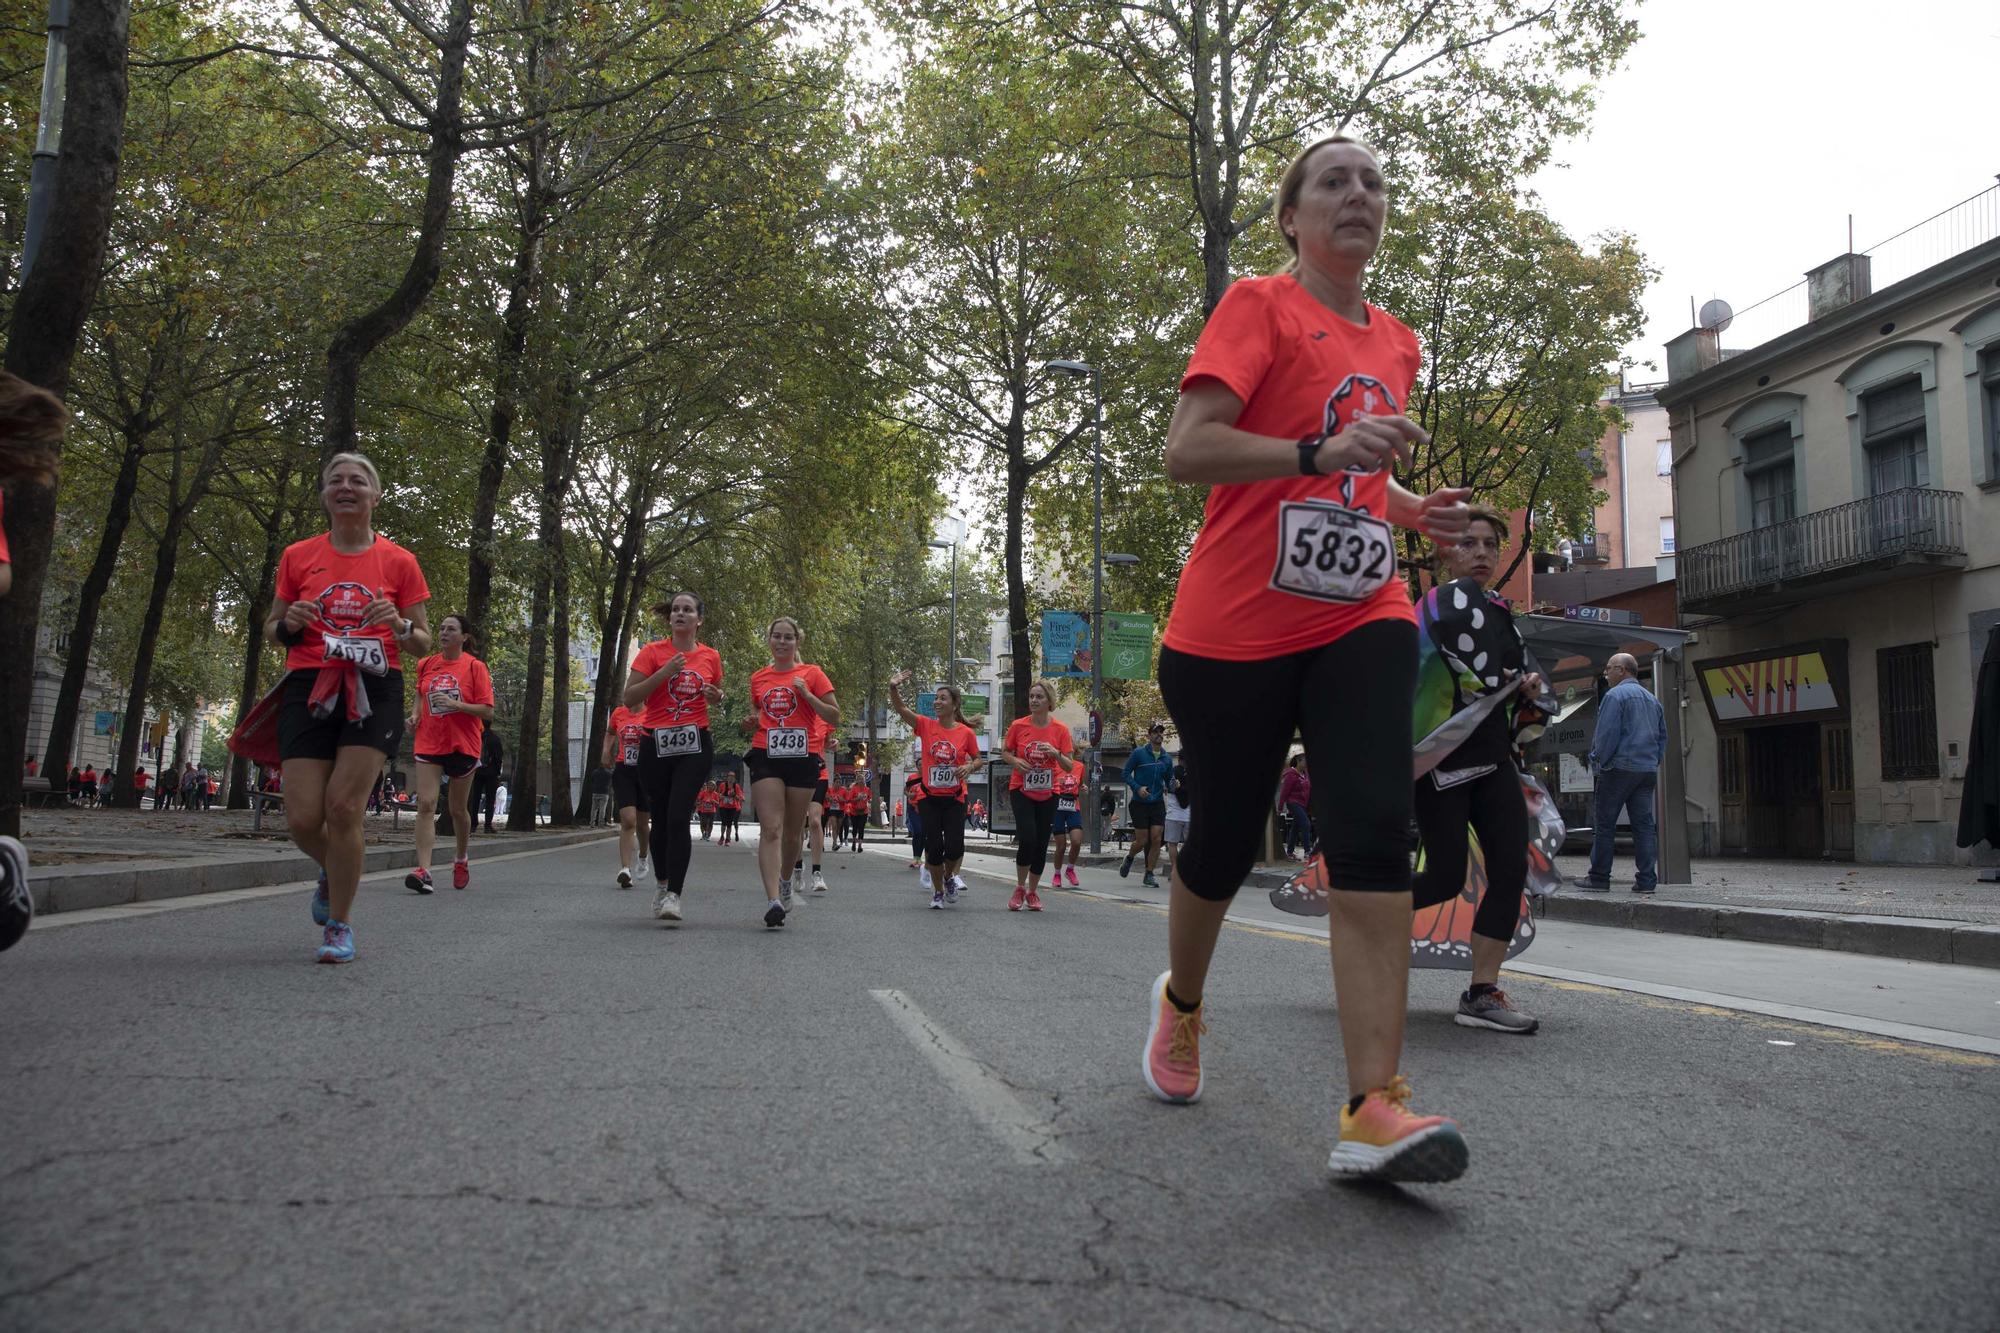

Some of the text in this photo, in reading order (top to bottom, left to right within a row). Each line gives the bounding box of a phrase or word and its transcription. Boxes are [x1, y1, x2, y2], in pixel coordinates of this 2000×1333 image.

[1290, 528, 1387, 580] 5832
[1050, 621, 1071, 632] Fires
[331, 644, 381, 665] 4076
[660, 731, 696, 748] 3439
[770, 734, 804, 749] 3438
[1559, 729, 1585, 744] girona
[1026, 774, 1050, 784] 4951
